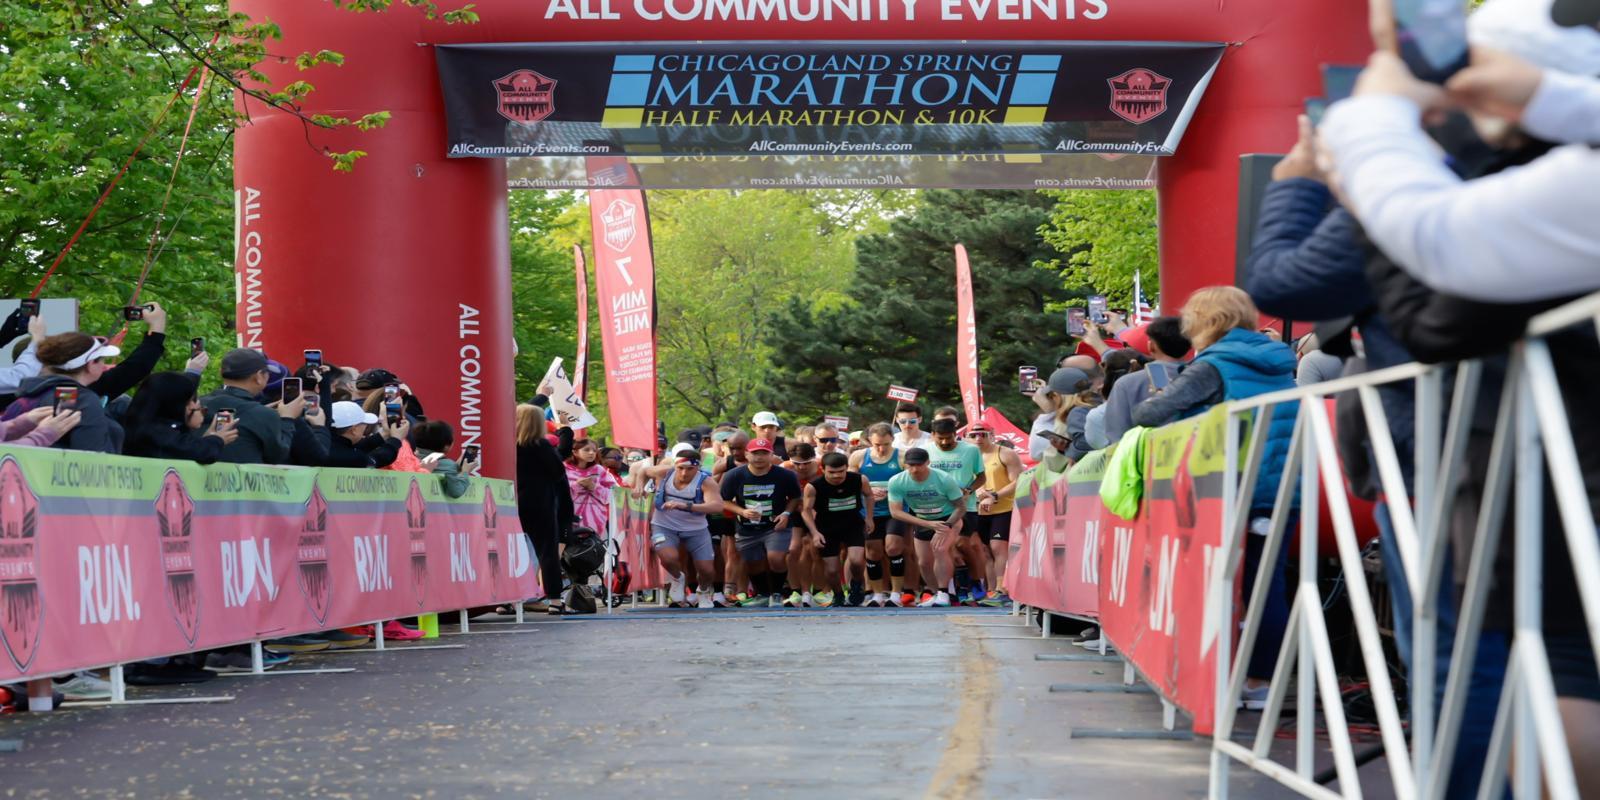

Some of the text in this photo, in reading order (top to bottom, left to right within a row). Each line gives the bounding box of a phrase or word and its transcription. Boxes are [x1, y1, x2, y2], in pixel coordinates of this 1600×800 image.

[544, 0, 1108, 21] ALL COMMUNITY EVENTS
[658, 54, 1013, 72] CHICAGOLAND SPRING
[648, 73, 1010, 106] MARATHON
[646, 109, 998, 127] HALF MARATHON & 10K
[451, 143, 610, 156] AllCommunityEvents.com
[749, 140, 913, 154] AllCommunityEvents.com
[245, 187, 263, 353] ALL COMMUN
[459, 303, 480, 339] ALL
[78, 543, 141, 625] RUN.
